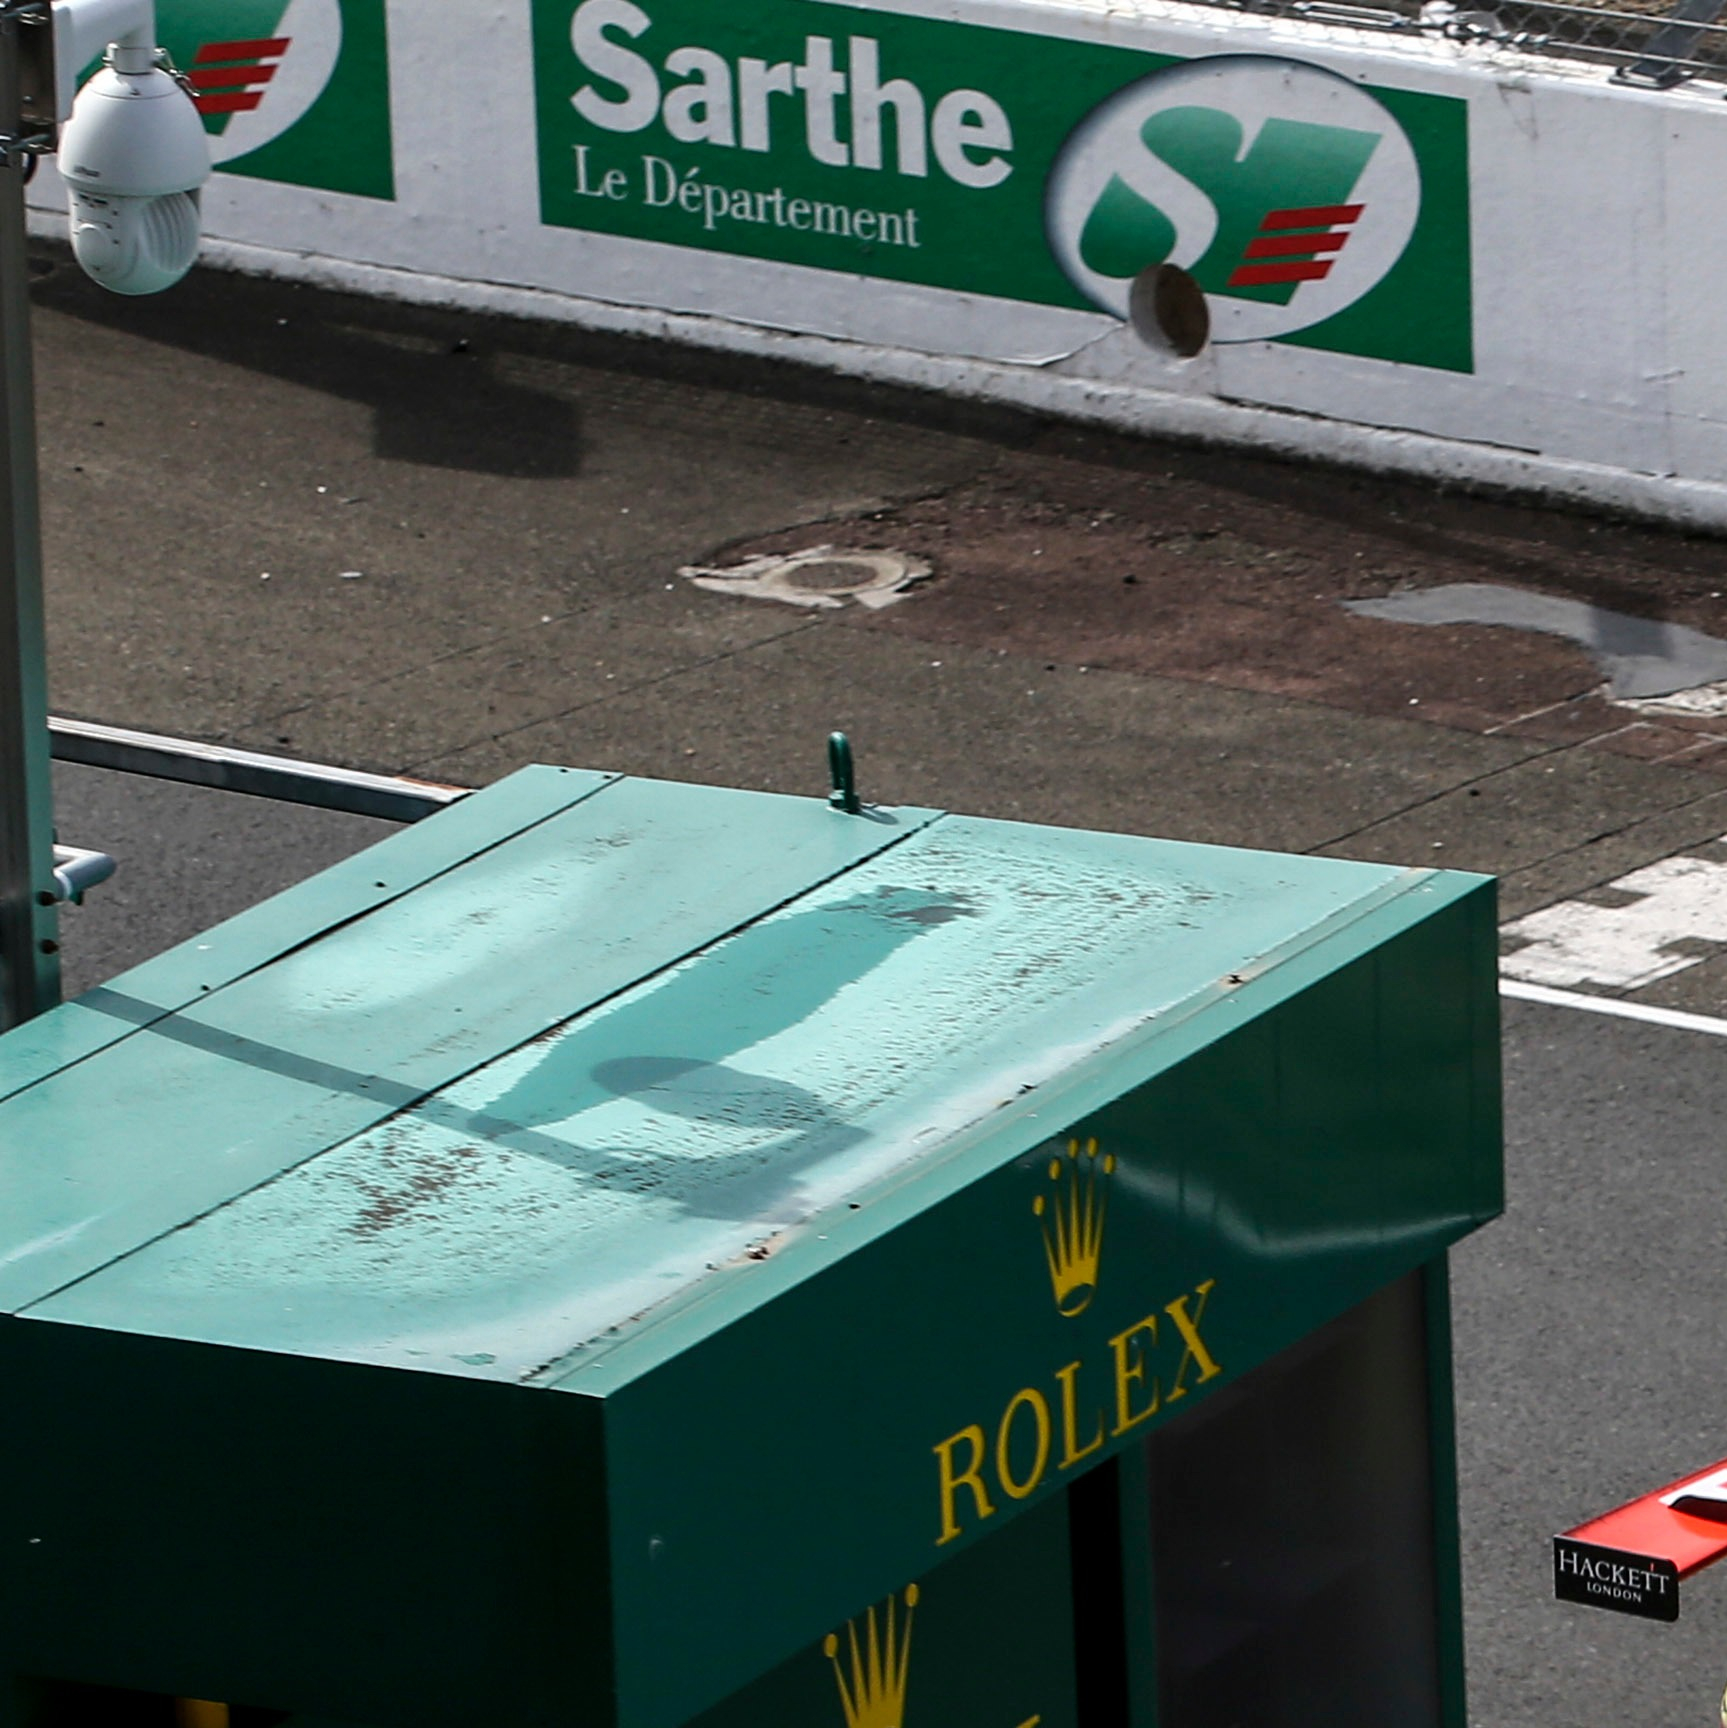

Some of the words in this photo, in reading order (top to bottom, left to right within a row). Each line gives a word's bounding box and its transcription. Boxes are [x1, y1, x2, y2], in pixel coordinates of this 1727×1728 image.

[570, 0, 1014, 188] Sarthe
[573, 145, 628, 199] Le
[641, 156, 921, 248] Département
[932, 1278, 1222, 1546] ROLEX
[1558, 1551, 1670, 1595] HACKETT
[1586, 1581, 1643, 1603] LONDON
